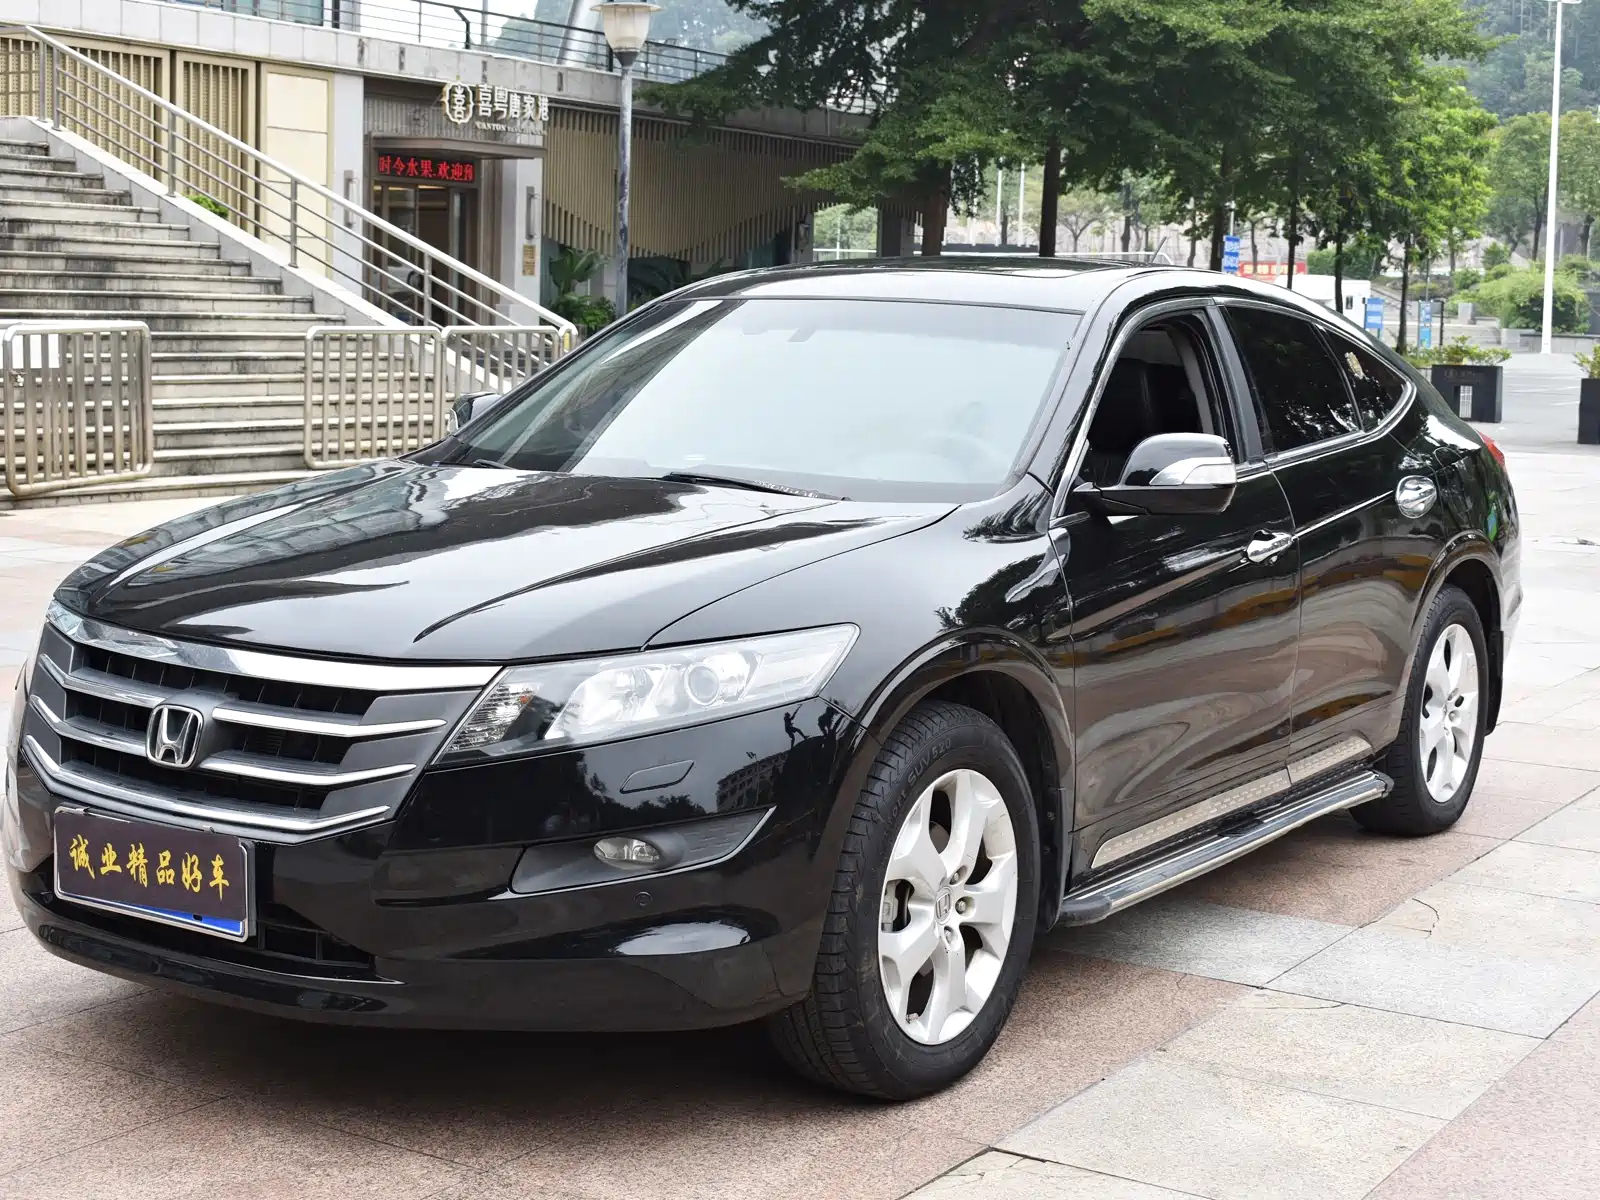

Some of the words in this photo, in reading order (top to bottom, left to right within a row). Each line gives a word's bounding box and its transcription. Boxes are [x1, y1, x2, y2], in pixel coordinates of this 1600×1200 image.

[68, 833, 231, 901] 诚业精品好车
